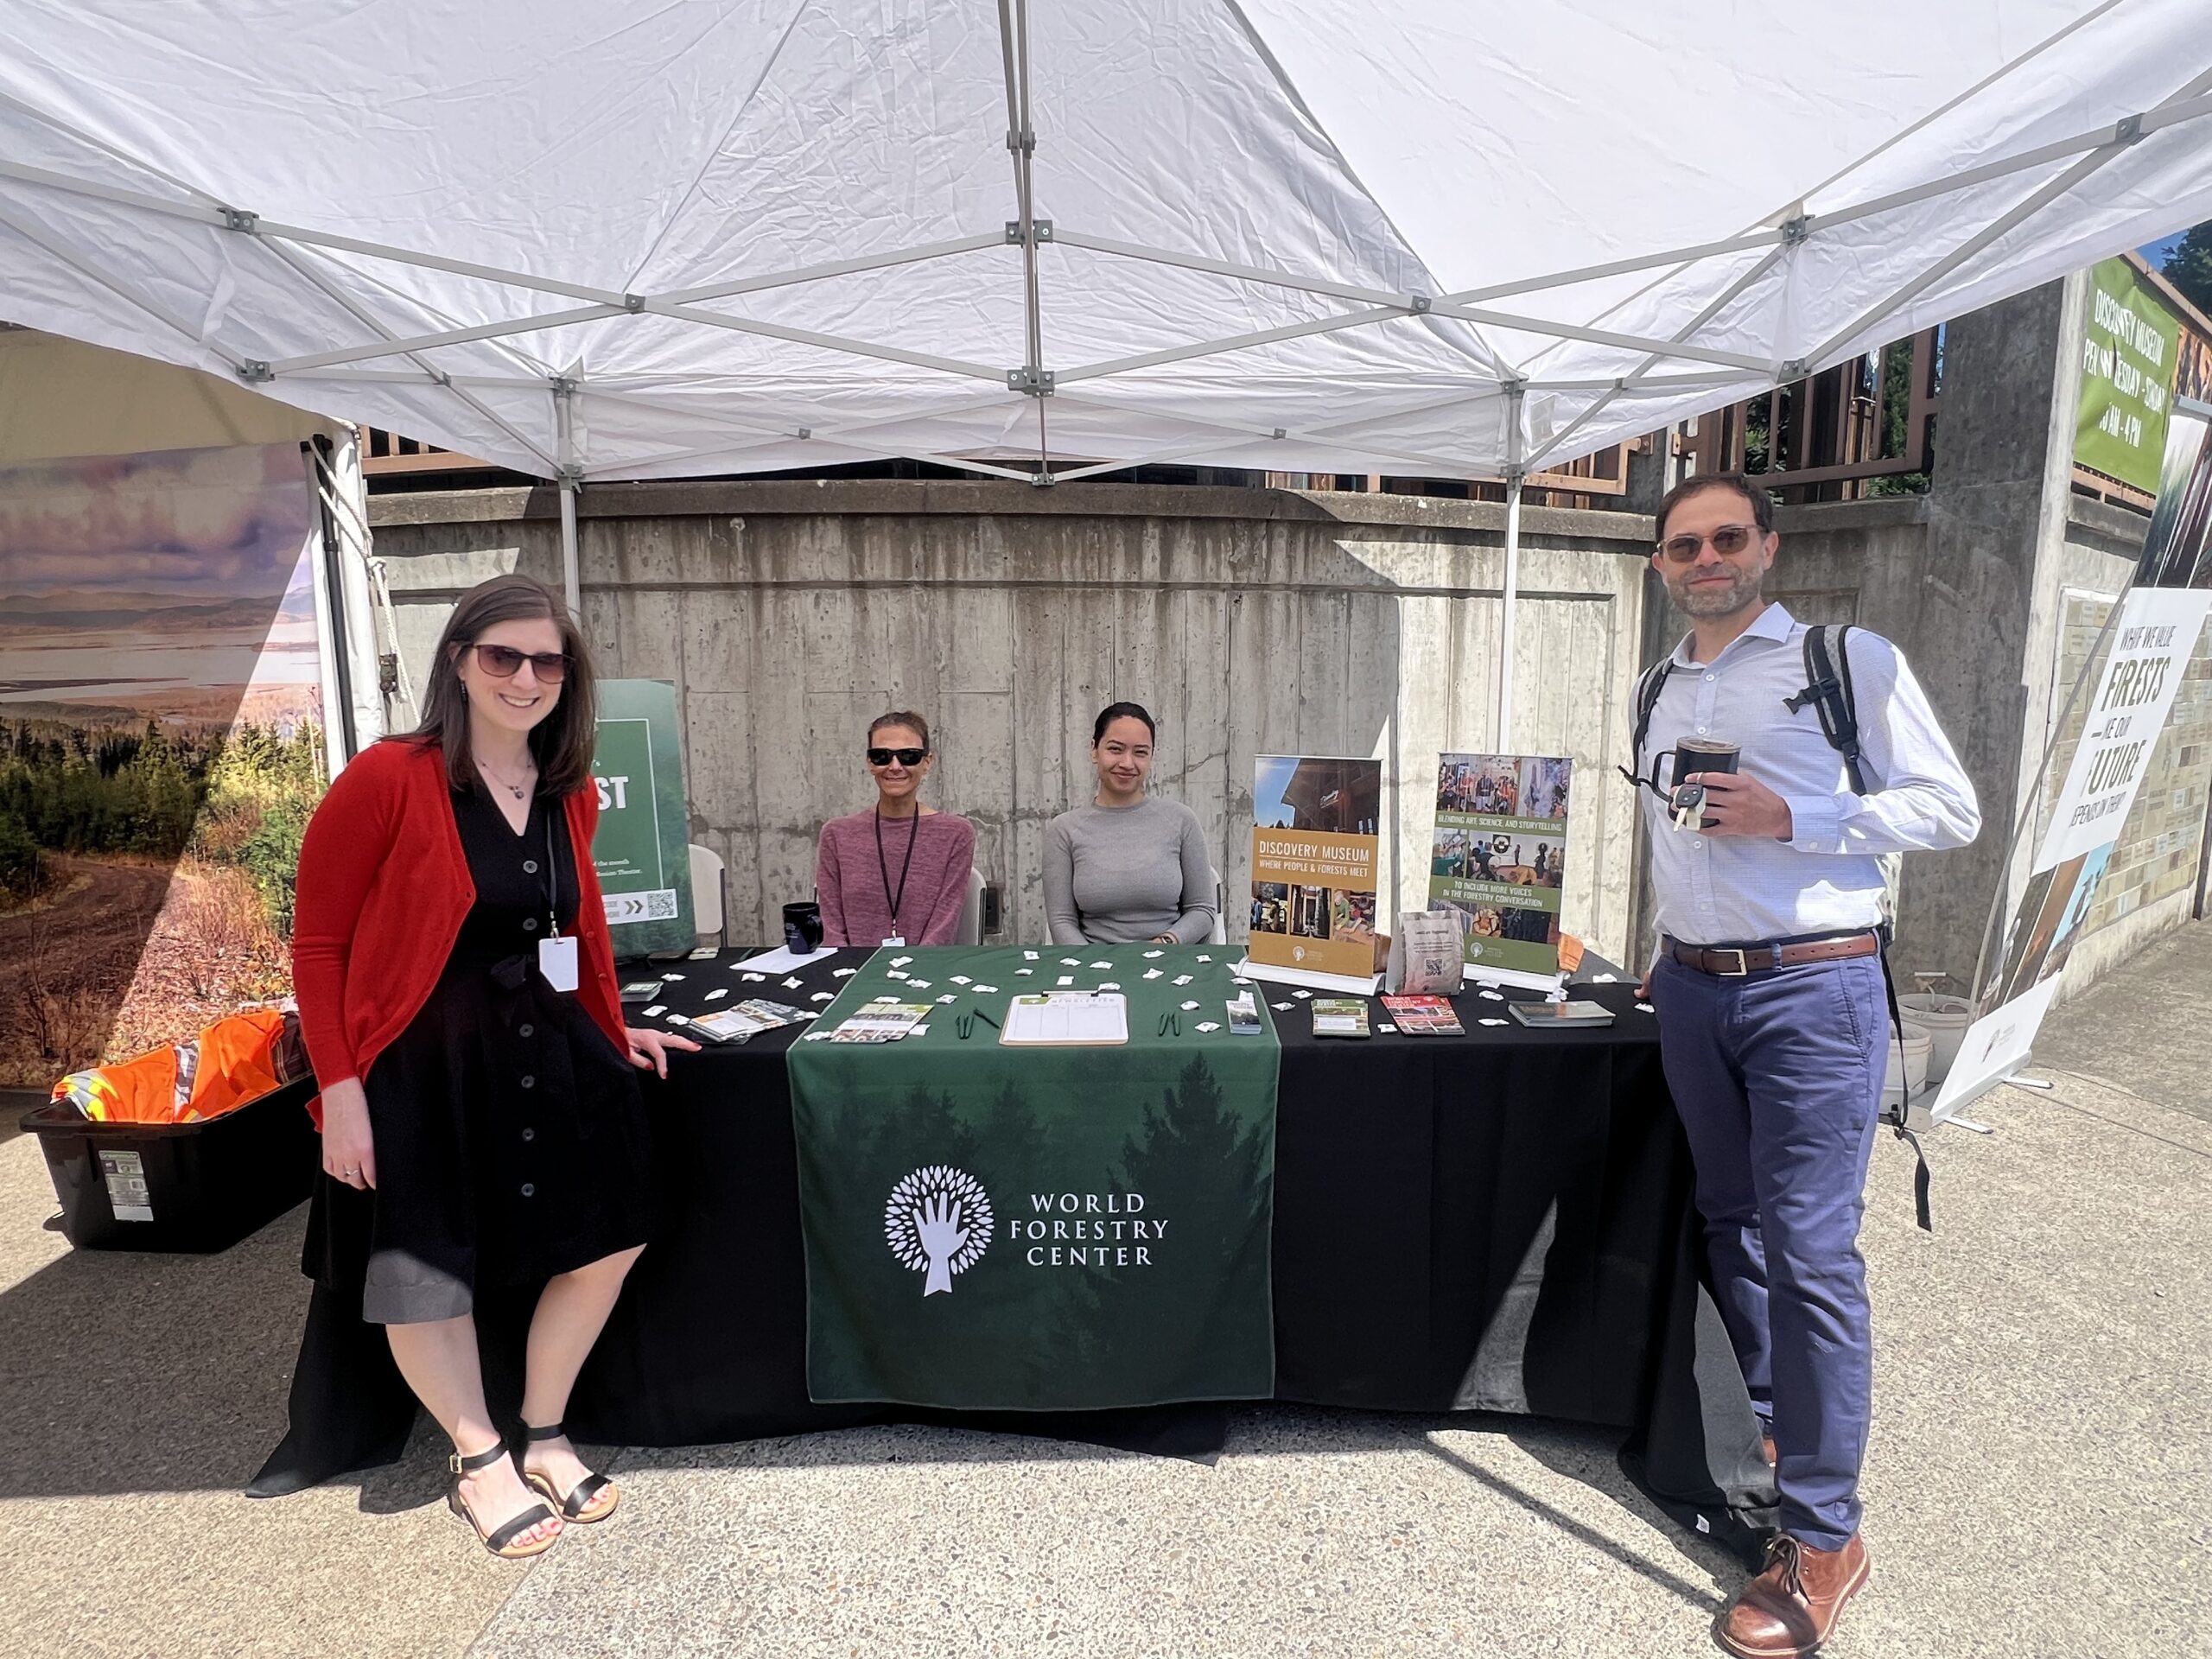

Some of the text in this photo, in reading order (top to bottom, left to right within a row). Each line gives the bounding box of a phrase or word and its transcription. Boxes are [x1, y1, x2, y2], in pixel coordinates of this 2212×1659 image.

[2083, 338, 2100, 376] PEN
[1437, 814, 1465, 825] BLENDING
[1504, 820, 1518, 830] AND
[1518, 821, 1563, 832] STORYTELLING
[1258, 840, 1370, 862] DISCOVERY MUSEUM
[1258, 859, 1369, 878] WHERE PEOPLE & FORESTS MEET
[1442, 888, 1543, 907] IN THE FORESTRY CONVERSATION
[1454, 880, 1533, 897] TO INCLUDE MORE VOICES
[1030, 1192, 1145, 1214] WORLD
[1010, 1218, 1169, 1240] FORESTRY
[1027, 1246, 1153, 1267] CENTER
